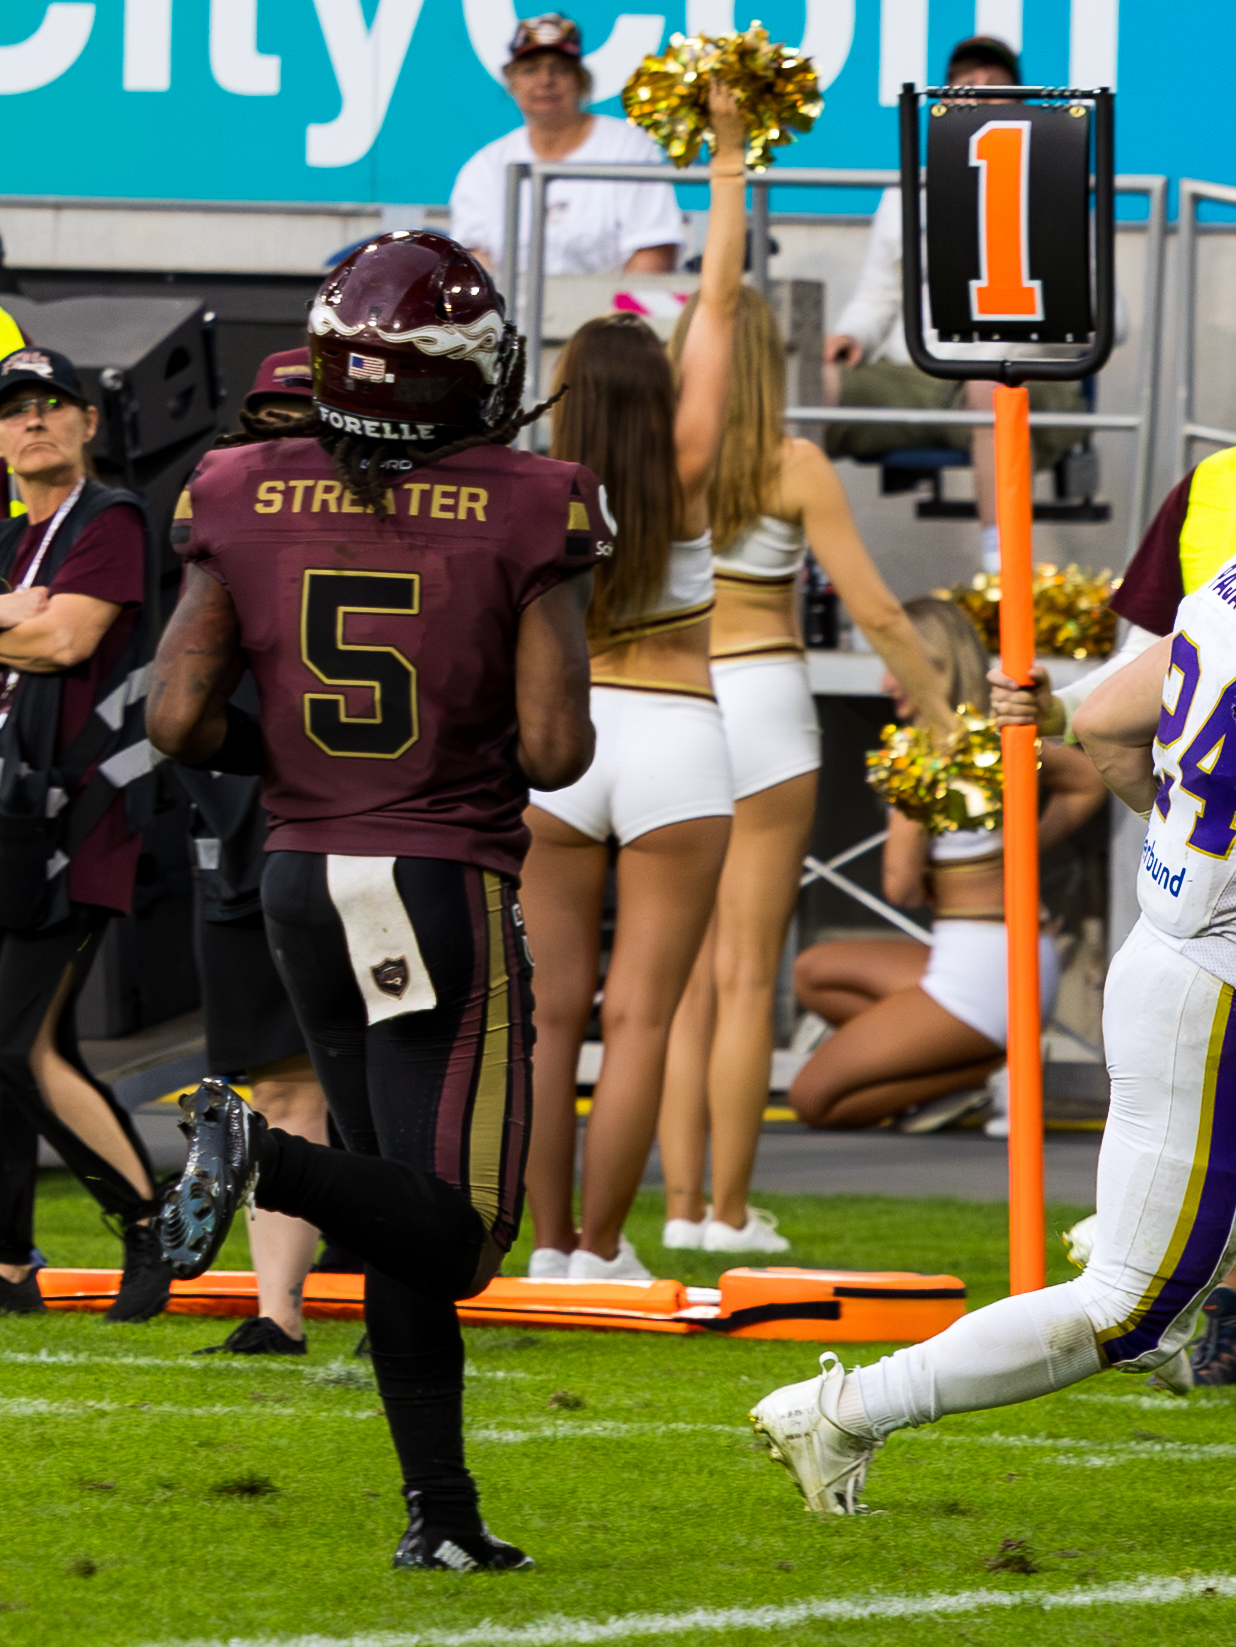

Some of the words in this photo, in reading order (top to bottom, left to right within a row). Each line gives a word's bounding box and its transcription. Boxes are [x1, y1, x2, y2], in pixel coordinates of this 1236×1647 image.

[968, 120, 1045, 321] 1
[319, 406, 436, 440] FORELLE
[302, 568, 420, 760] 5
